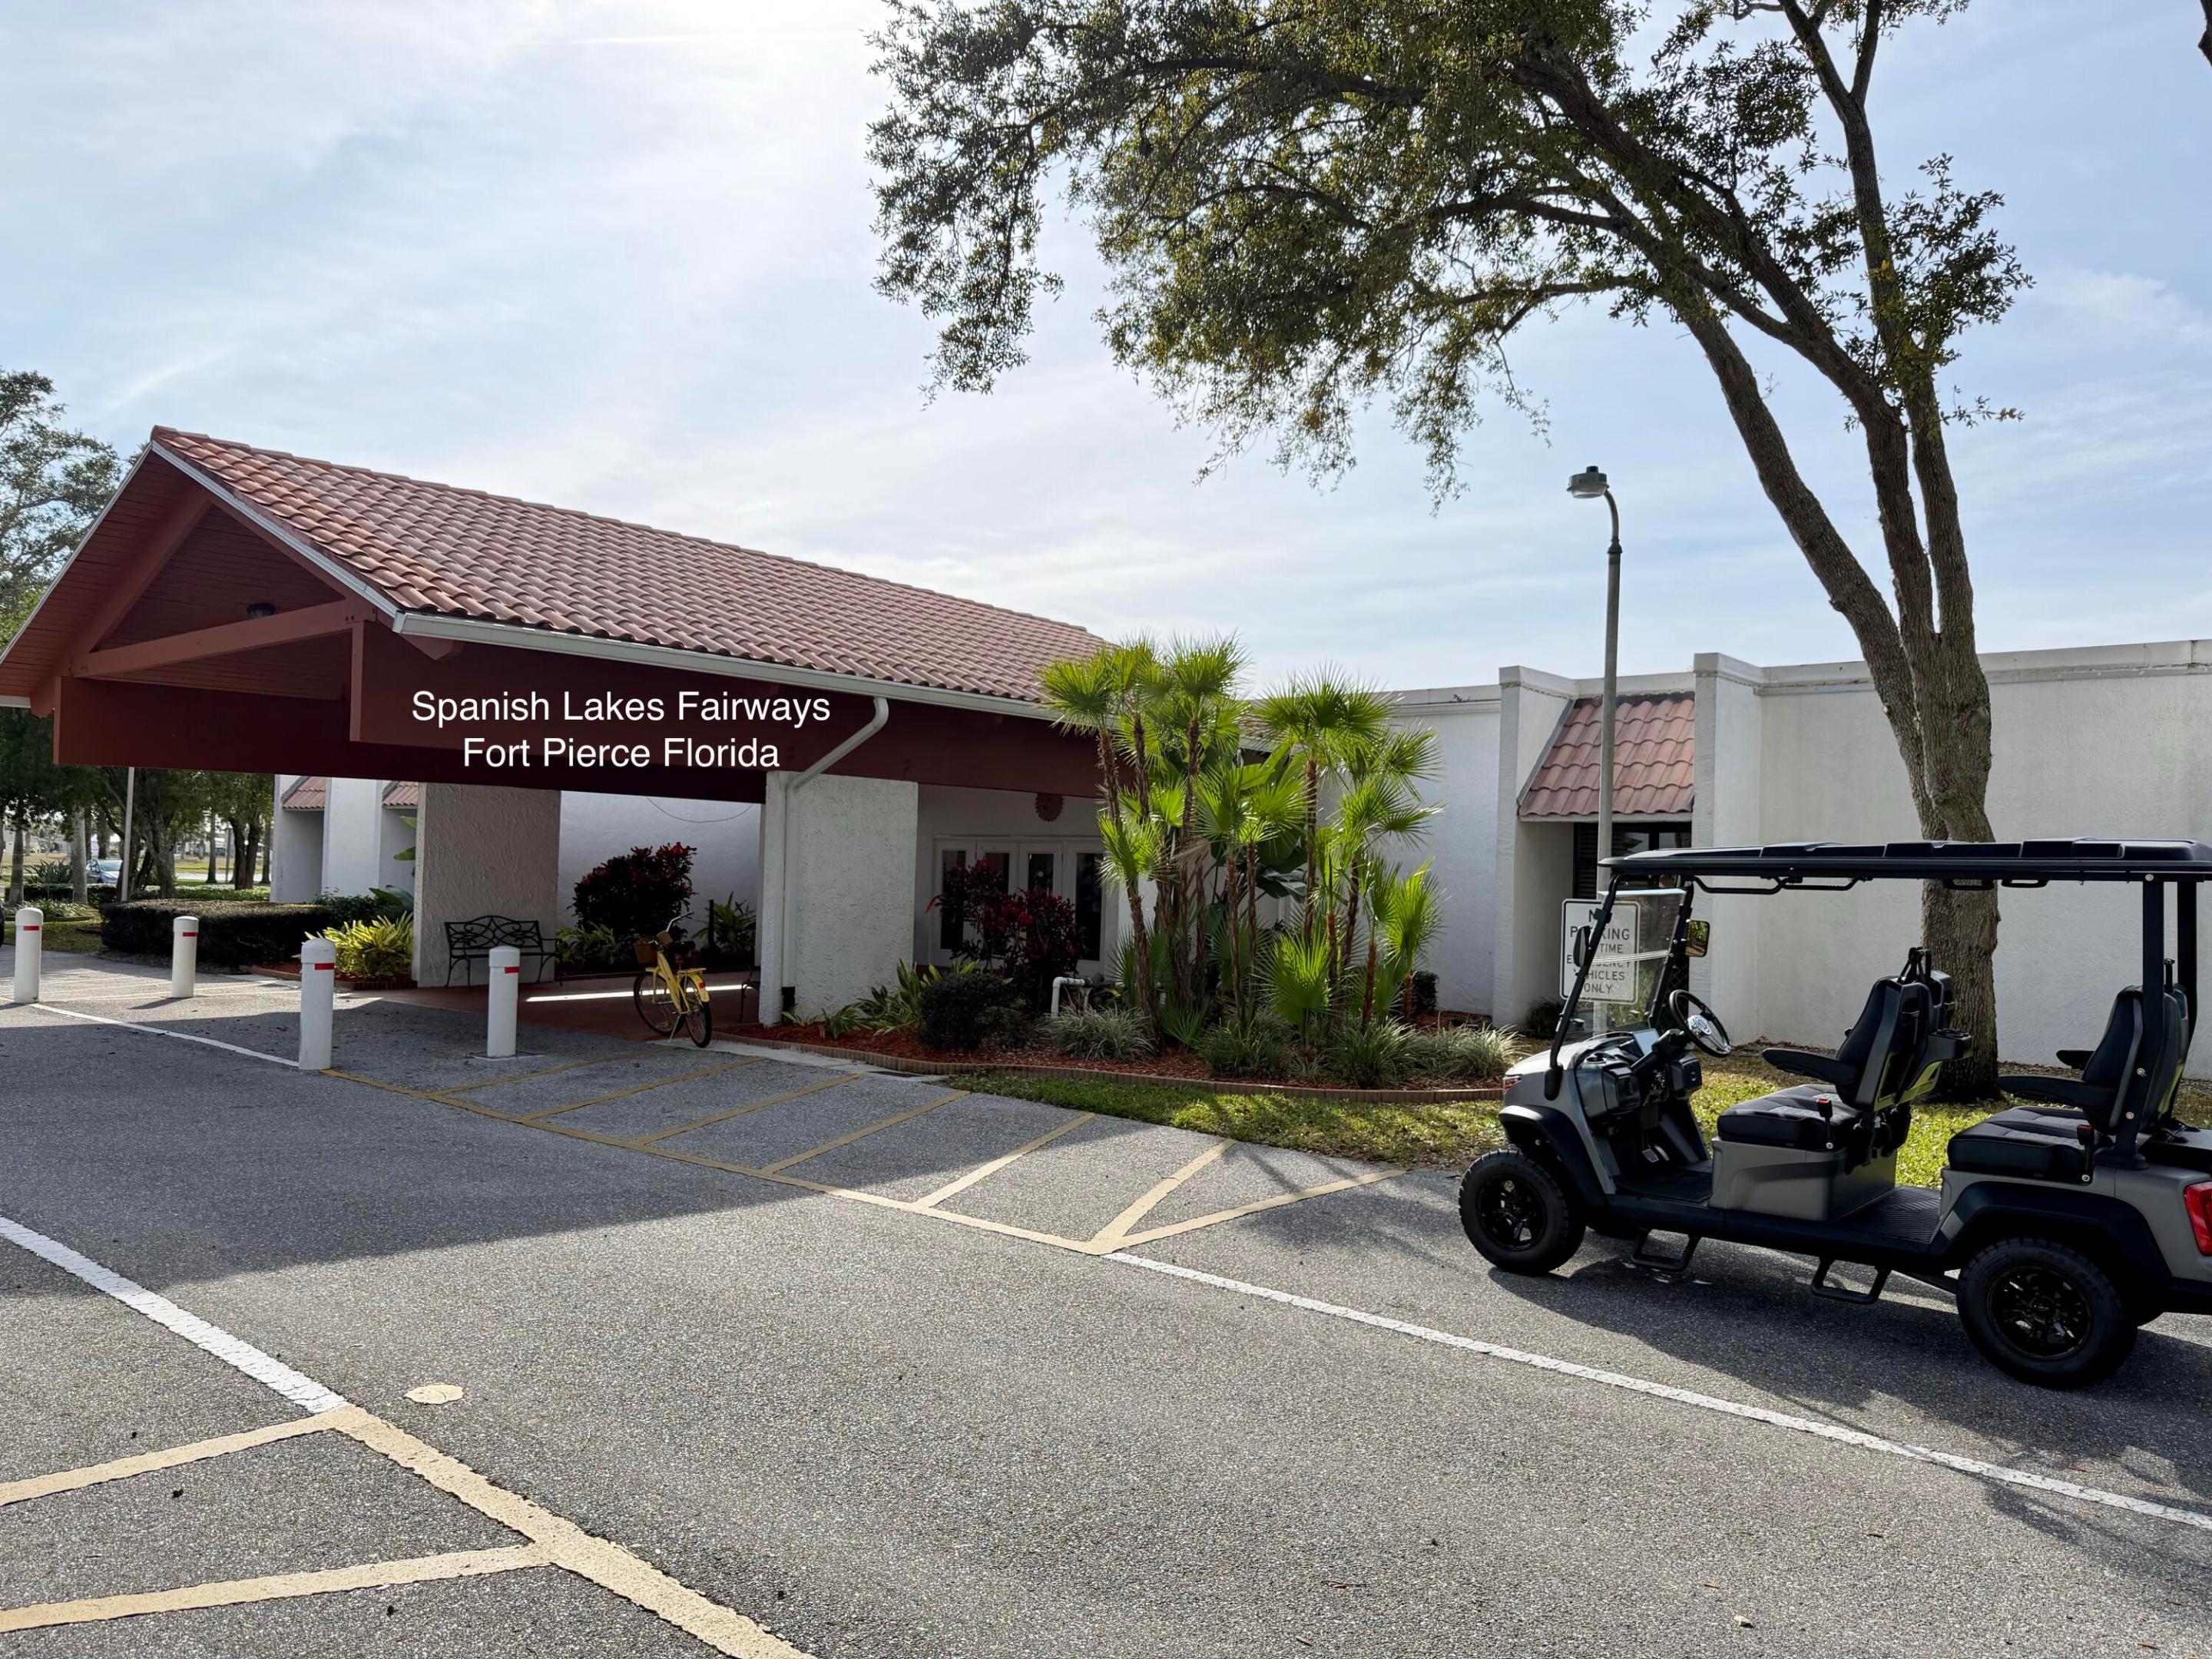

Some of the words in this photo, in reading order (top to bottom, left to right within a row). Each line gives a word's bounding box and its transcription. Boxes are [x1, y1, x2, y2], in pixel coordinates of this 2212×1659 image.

[1600, 943, 1624, 953] TIME
[1573, 969, 1625, 981] HICLES
[1584, 983, 1613, 993] ONLY
